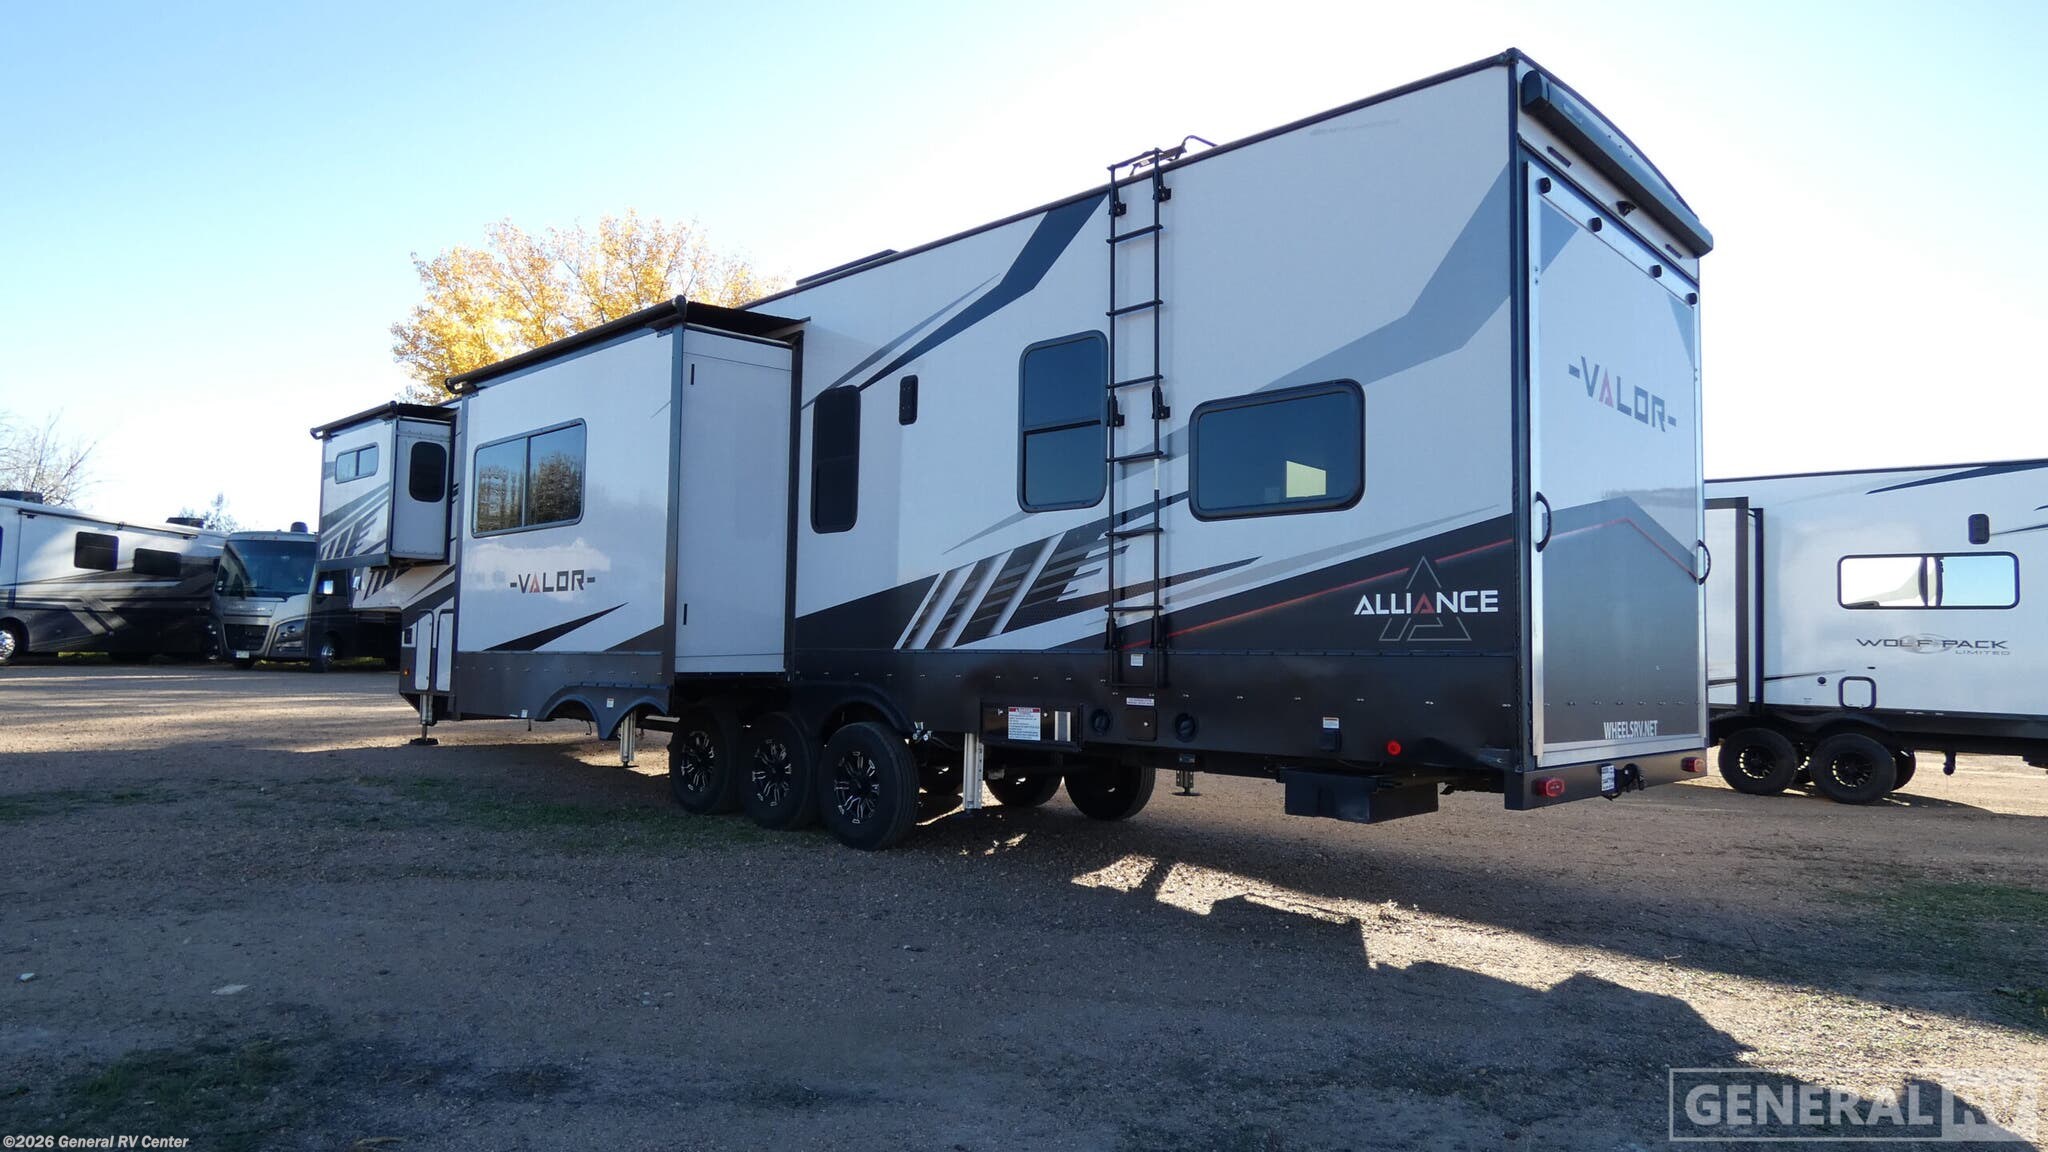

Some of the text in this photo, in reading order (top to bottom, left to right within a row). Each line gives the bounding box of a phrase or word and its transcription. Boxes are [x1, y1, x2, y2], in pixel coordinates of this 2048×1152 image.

[1353, 589, 1499, 615] ALLIANCE
[1856, 638, 2009, 649] WOLF PACK
[1603, 719, 1658, 740] WHEELSRV.NET
